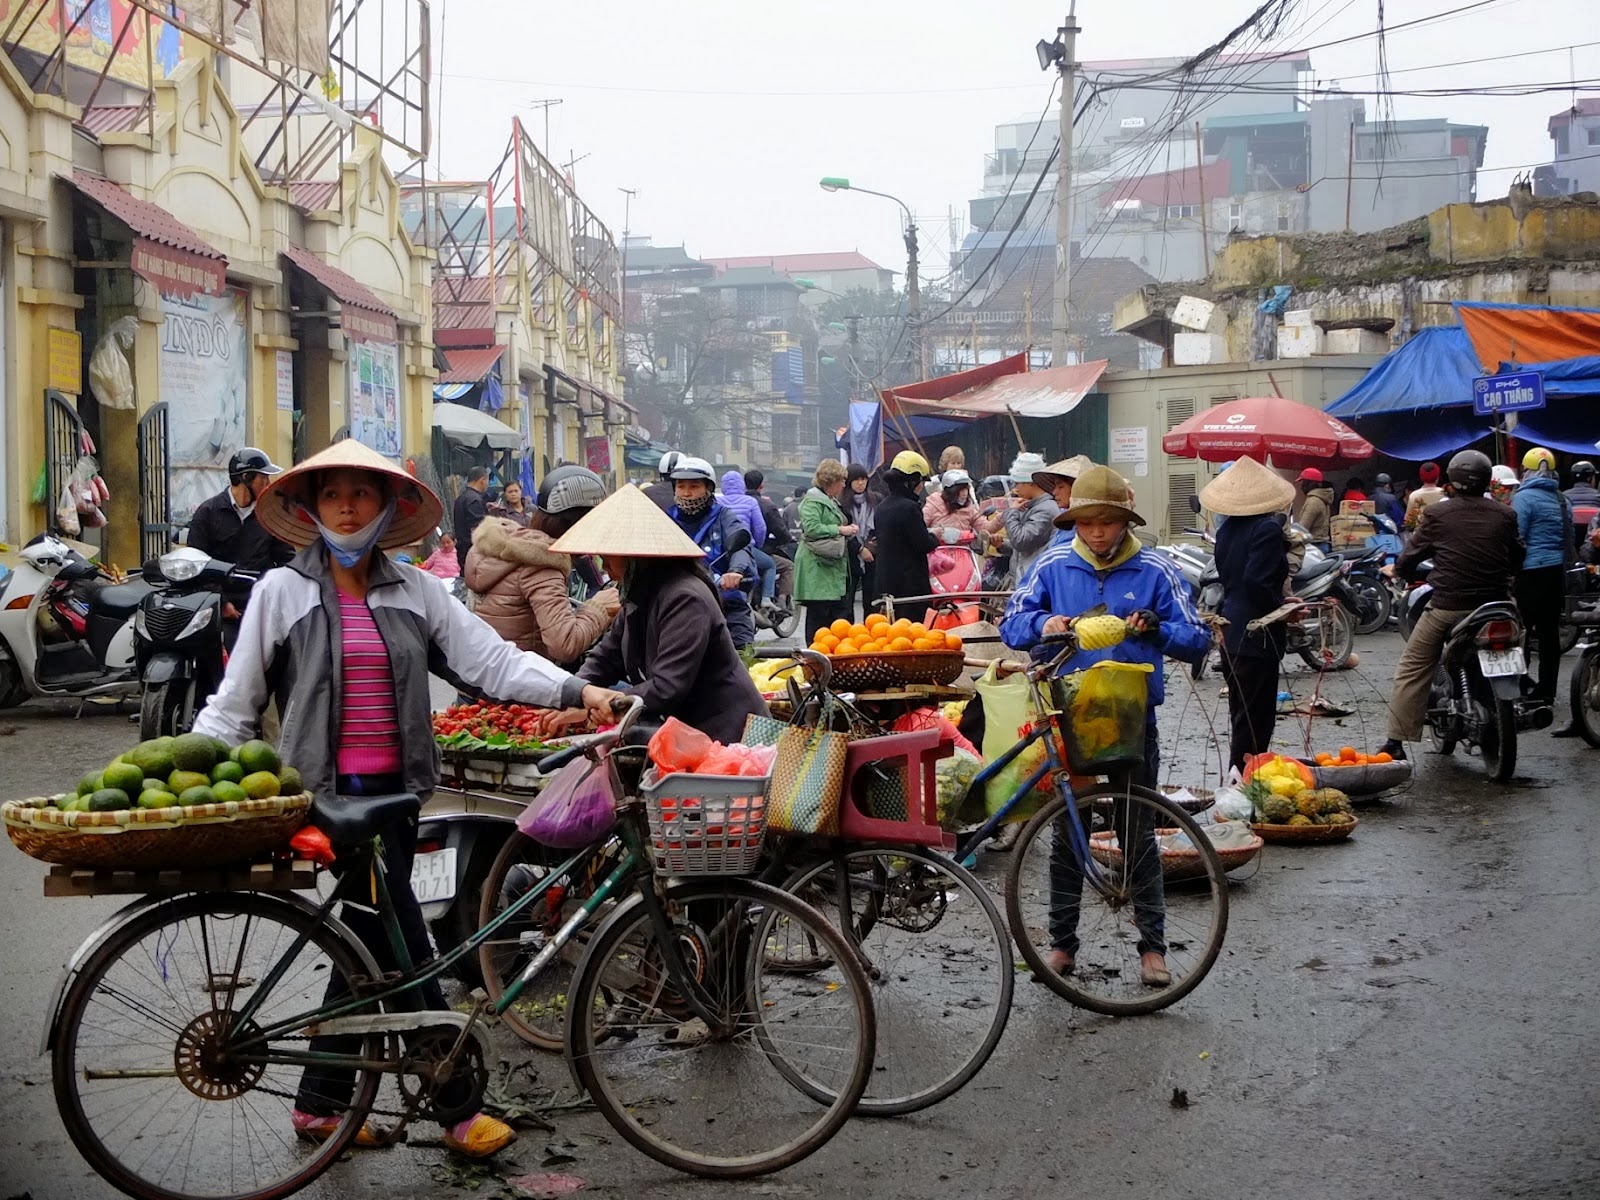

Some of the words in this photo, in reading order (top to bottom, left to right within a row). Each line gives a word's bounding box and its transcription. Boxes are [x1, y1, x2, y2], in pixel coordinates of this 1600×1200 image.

[1495, 378, 1520, 388] PHỐ
[1483, 391, 1502, 407] CAO
[1199, 440, 1253, 448] www.vietbank.com.vn
[1270, 441, 1327, 453] www.vietbank.com.vn
[1488, 661, 1520, 674] 7101
[412, 854, 446, 878] 9-F1
